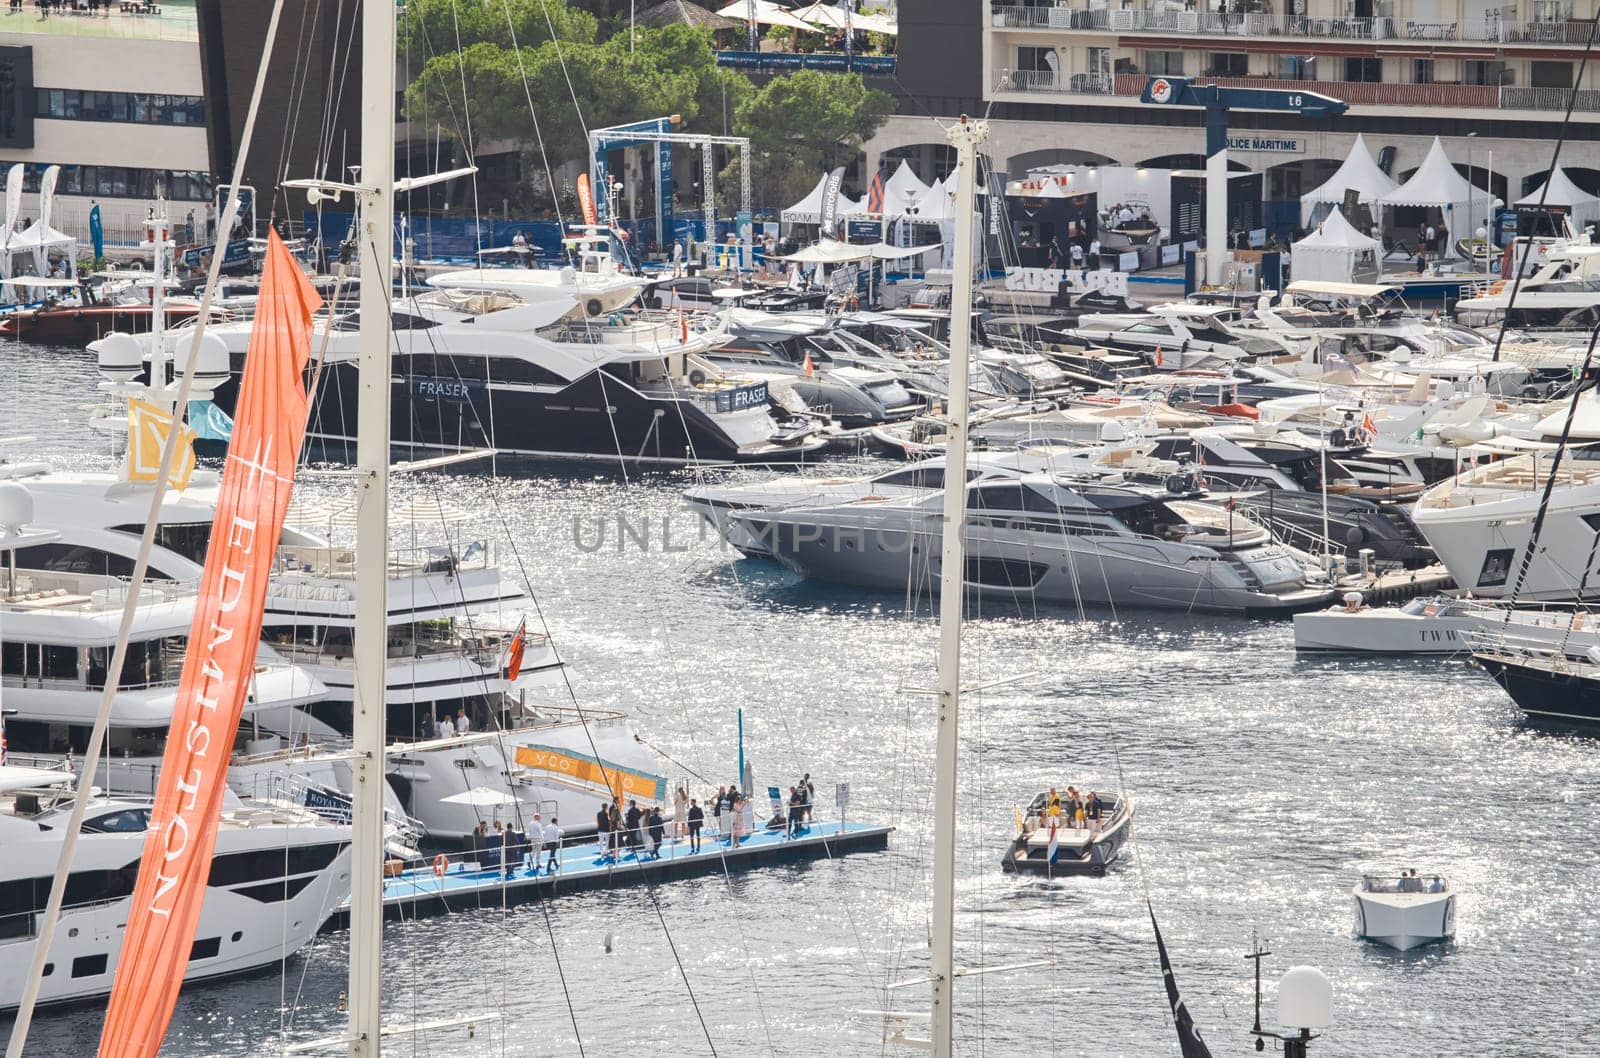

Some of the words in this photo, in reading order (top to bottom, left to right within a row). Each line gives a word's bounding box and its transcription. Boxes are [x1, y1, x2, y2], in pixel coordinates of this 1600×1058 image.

[1226, 139, 1250, 149] OLICE
[1252, 140, 1297, 151] MARITIME
[783, 212, 812, 222] ROAM
[419, 382, 469, 397] FRASER
[735, 387, 766, 407] FRASER
[148, 514, 258, 921] EDMISTON
[310, 793, 337, 809] ROYAL
